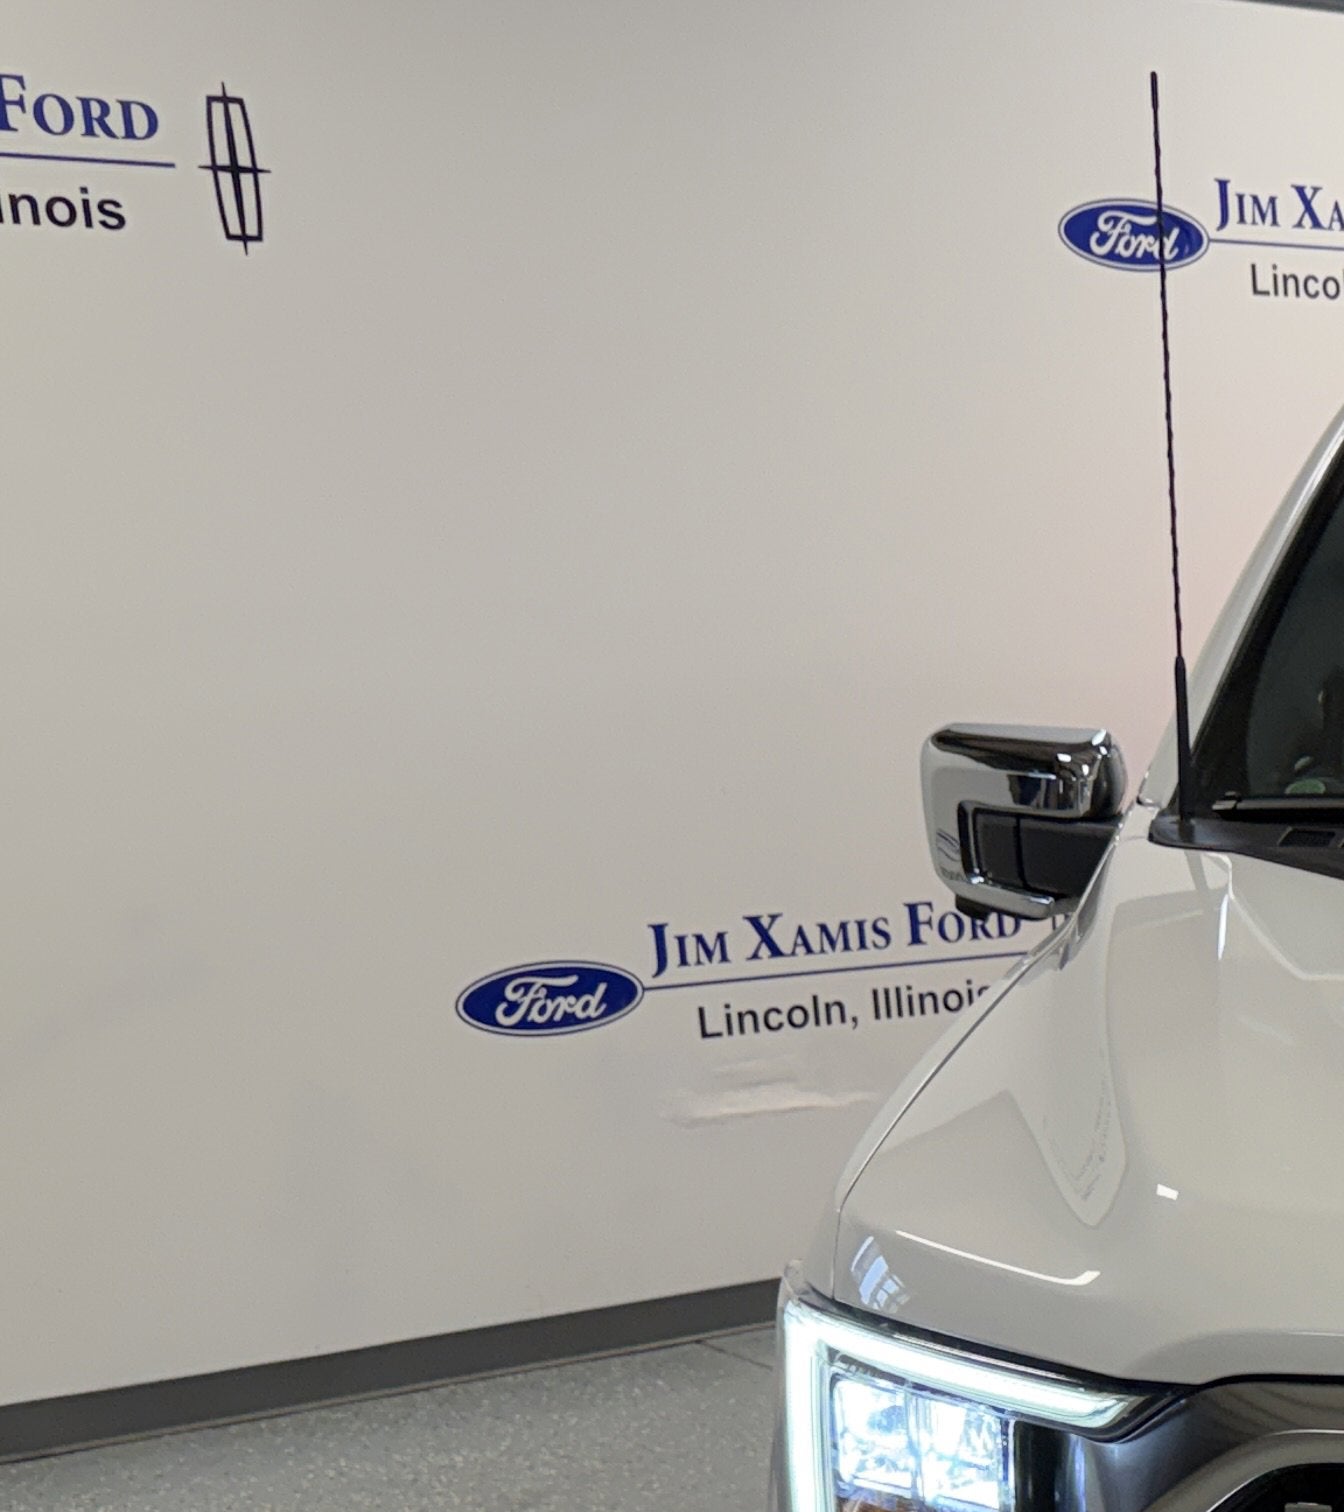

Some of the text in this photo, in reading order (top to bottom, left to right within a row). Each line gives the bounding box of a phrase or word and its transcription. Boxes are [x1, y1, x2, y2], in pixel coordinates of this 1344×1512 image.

[1089, 210, 1180, 261] Ford
[494, 974, 608, 1026] Ford
[699, 993, 859, 1039] Lincoln,
